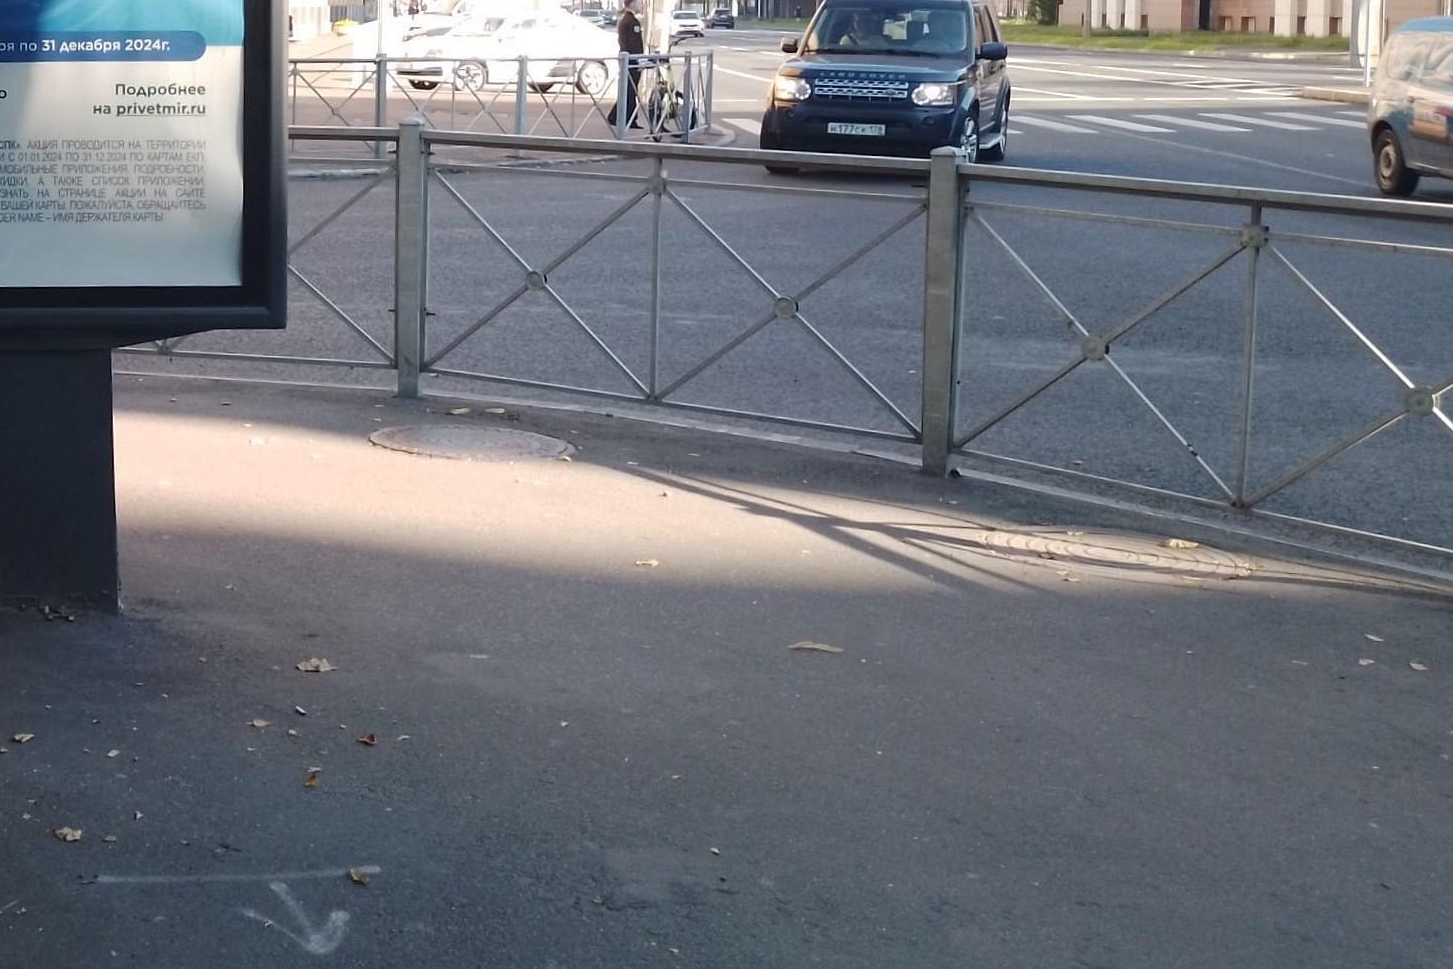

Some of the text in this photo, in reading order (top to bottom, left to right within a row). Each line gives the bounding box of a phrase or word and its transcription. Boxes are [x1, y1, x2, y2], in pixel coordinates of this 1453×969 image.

[20, 41, 38, 52] по
[42, 39, 56, 51] 31
[60, 38, 121, 53] декабря
[125, 38, 171, 51] 2024г.
[115, 83, 206, 98] Подробнее
[93, 102, 206, 118] на privetmir.ru
[27, 140, 57, 150] АКЦИЯ
[62, 140, 124, 150] ПРОВОДИТСЯ
[129, 140, 140, 150] НА
[18, 213, 43, 223] NAME
[54, 213, 73, 223] ИМЯ
[75, 213, 131, 222] ДЕРЖАТЕЛЯ
